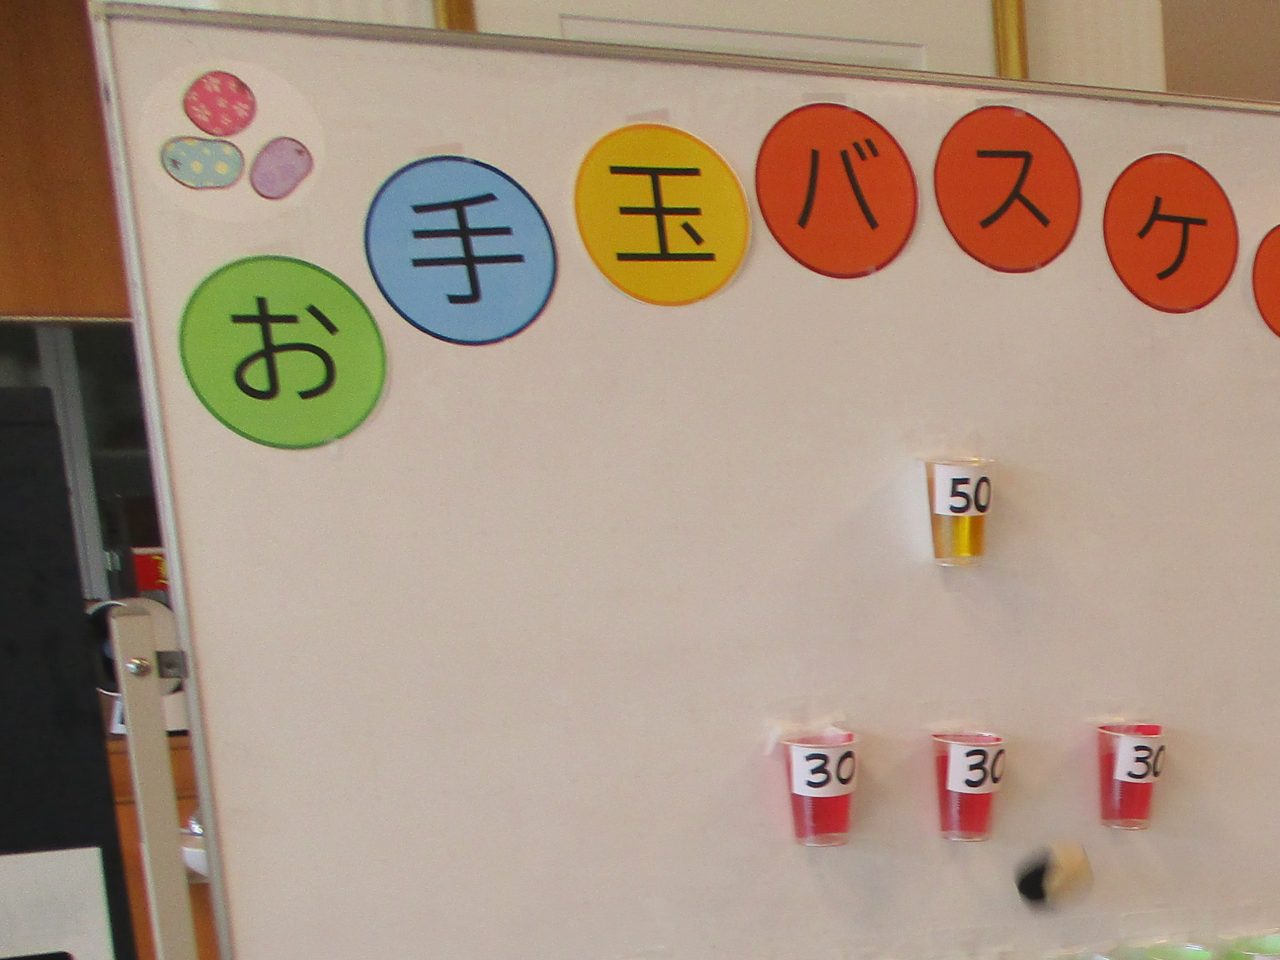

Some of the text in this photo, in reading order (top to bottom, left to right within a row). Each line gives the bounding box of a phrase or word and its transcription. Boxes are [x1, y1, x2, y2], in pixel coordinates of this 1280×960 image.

[949, 476, 992, 514] 50
[805, 750, 856, 788] 30
[964, 748, 1005, 788] 30
